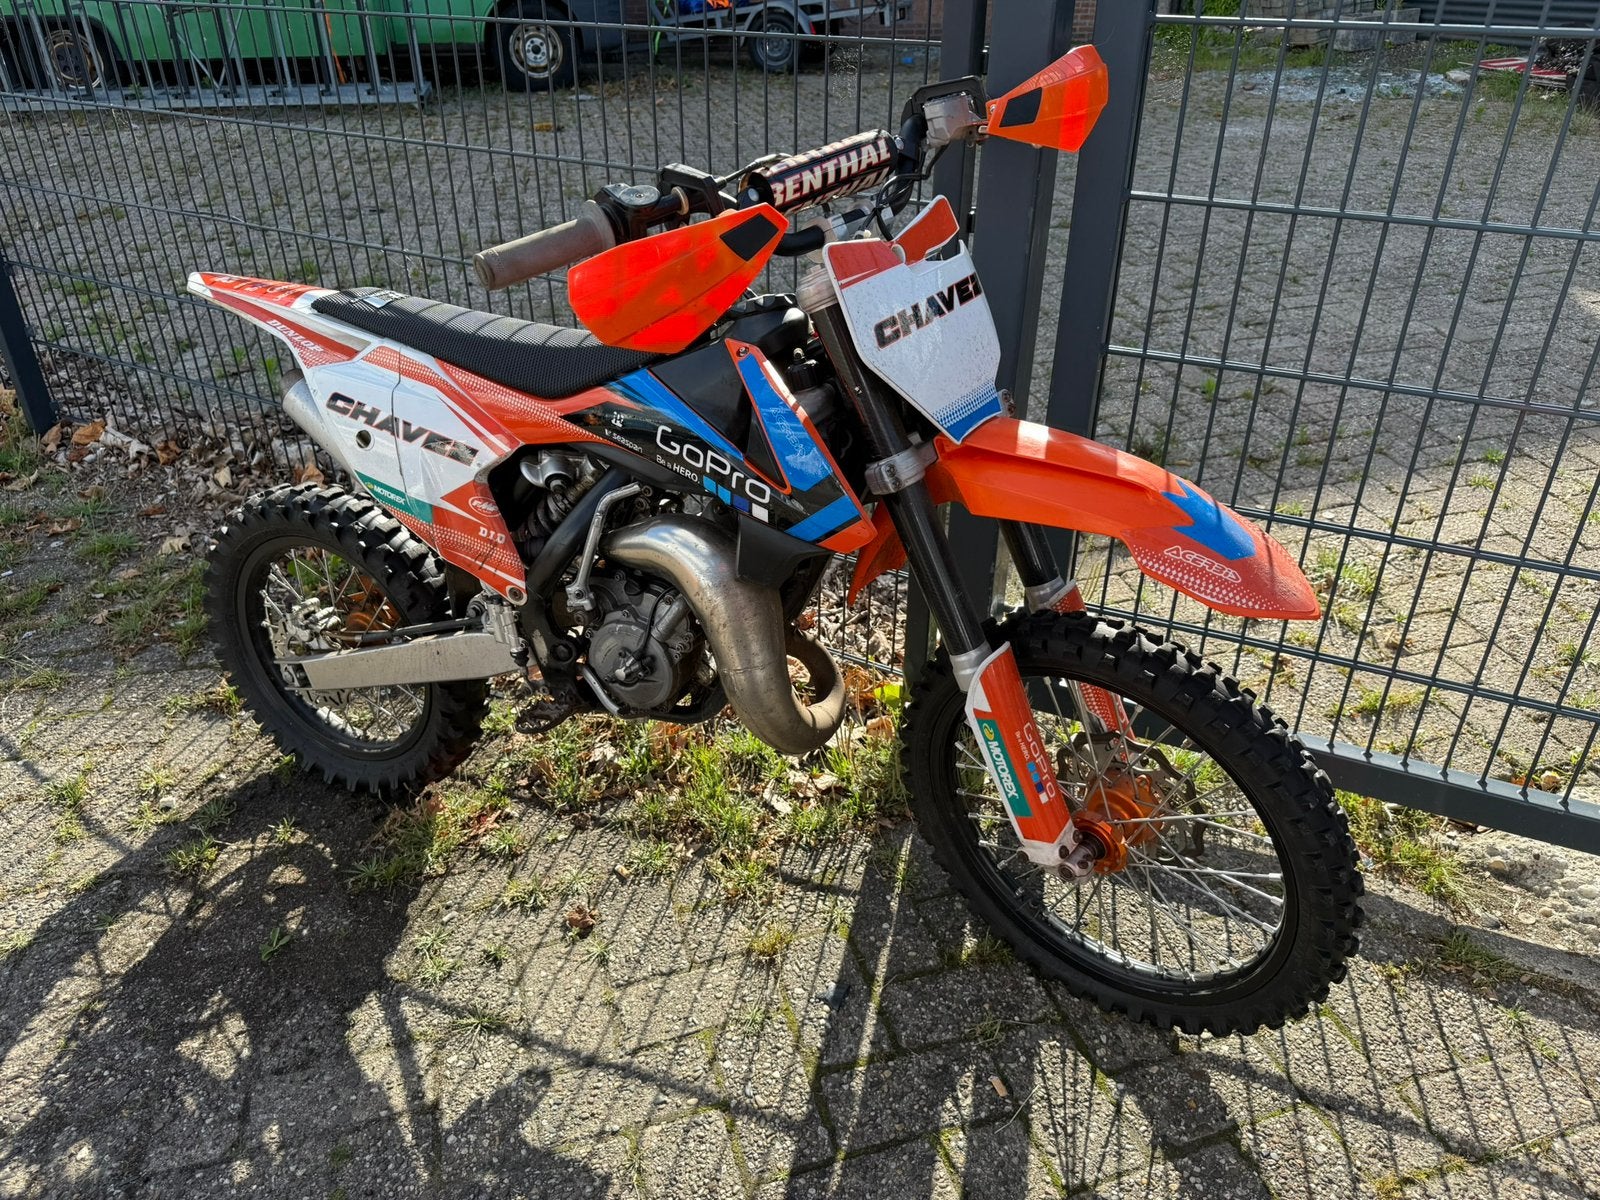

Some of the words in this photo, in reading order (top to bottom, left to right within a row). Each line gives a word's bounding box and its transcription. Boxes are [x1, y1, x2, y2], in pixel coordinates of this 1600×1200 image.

[612, 433, 643, 453] seaspan
[656, 454, 666, 466] Be
[656, 425, 771, 504] GoPro
[373, 484, 405, 506] MOTOREX
[988, 741, 1019, 799] MOTOREX
[1024, 722, 1056, 798] GoPro
